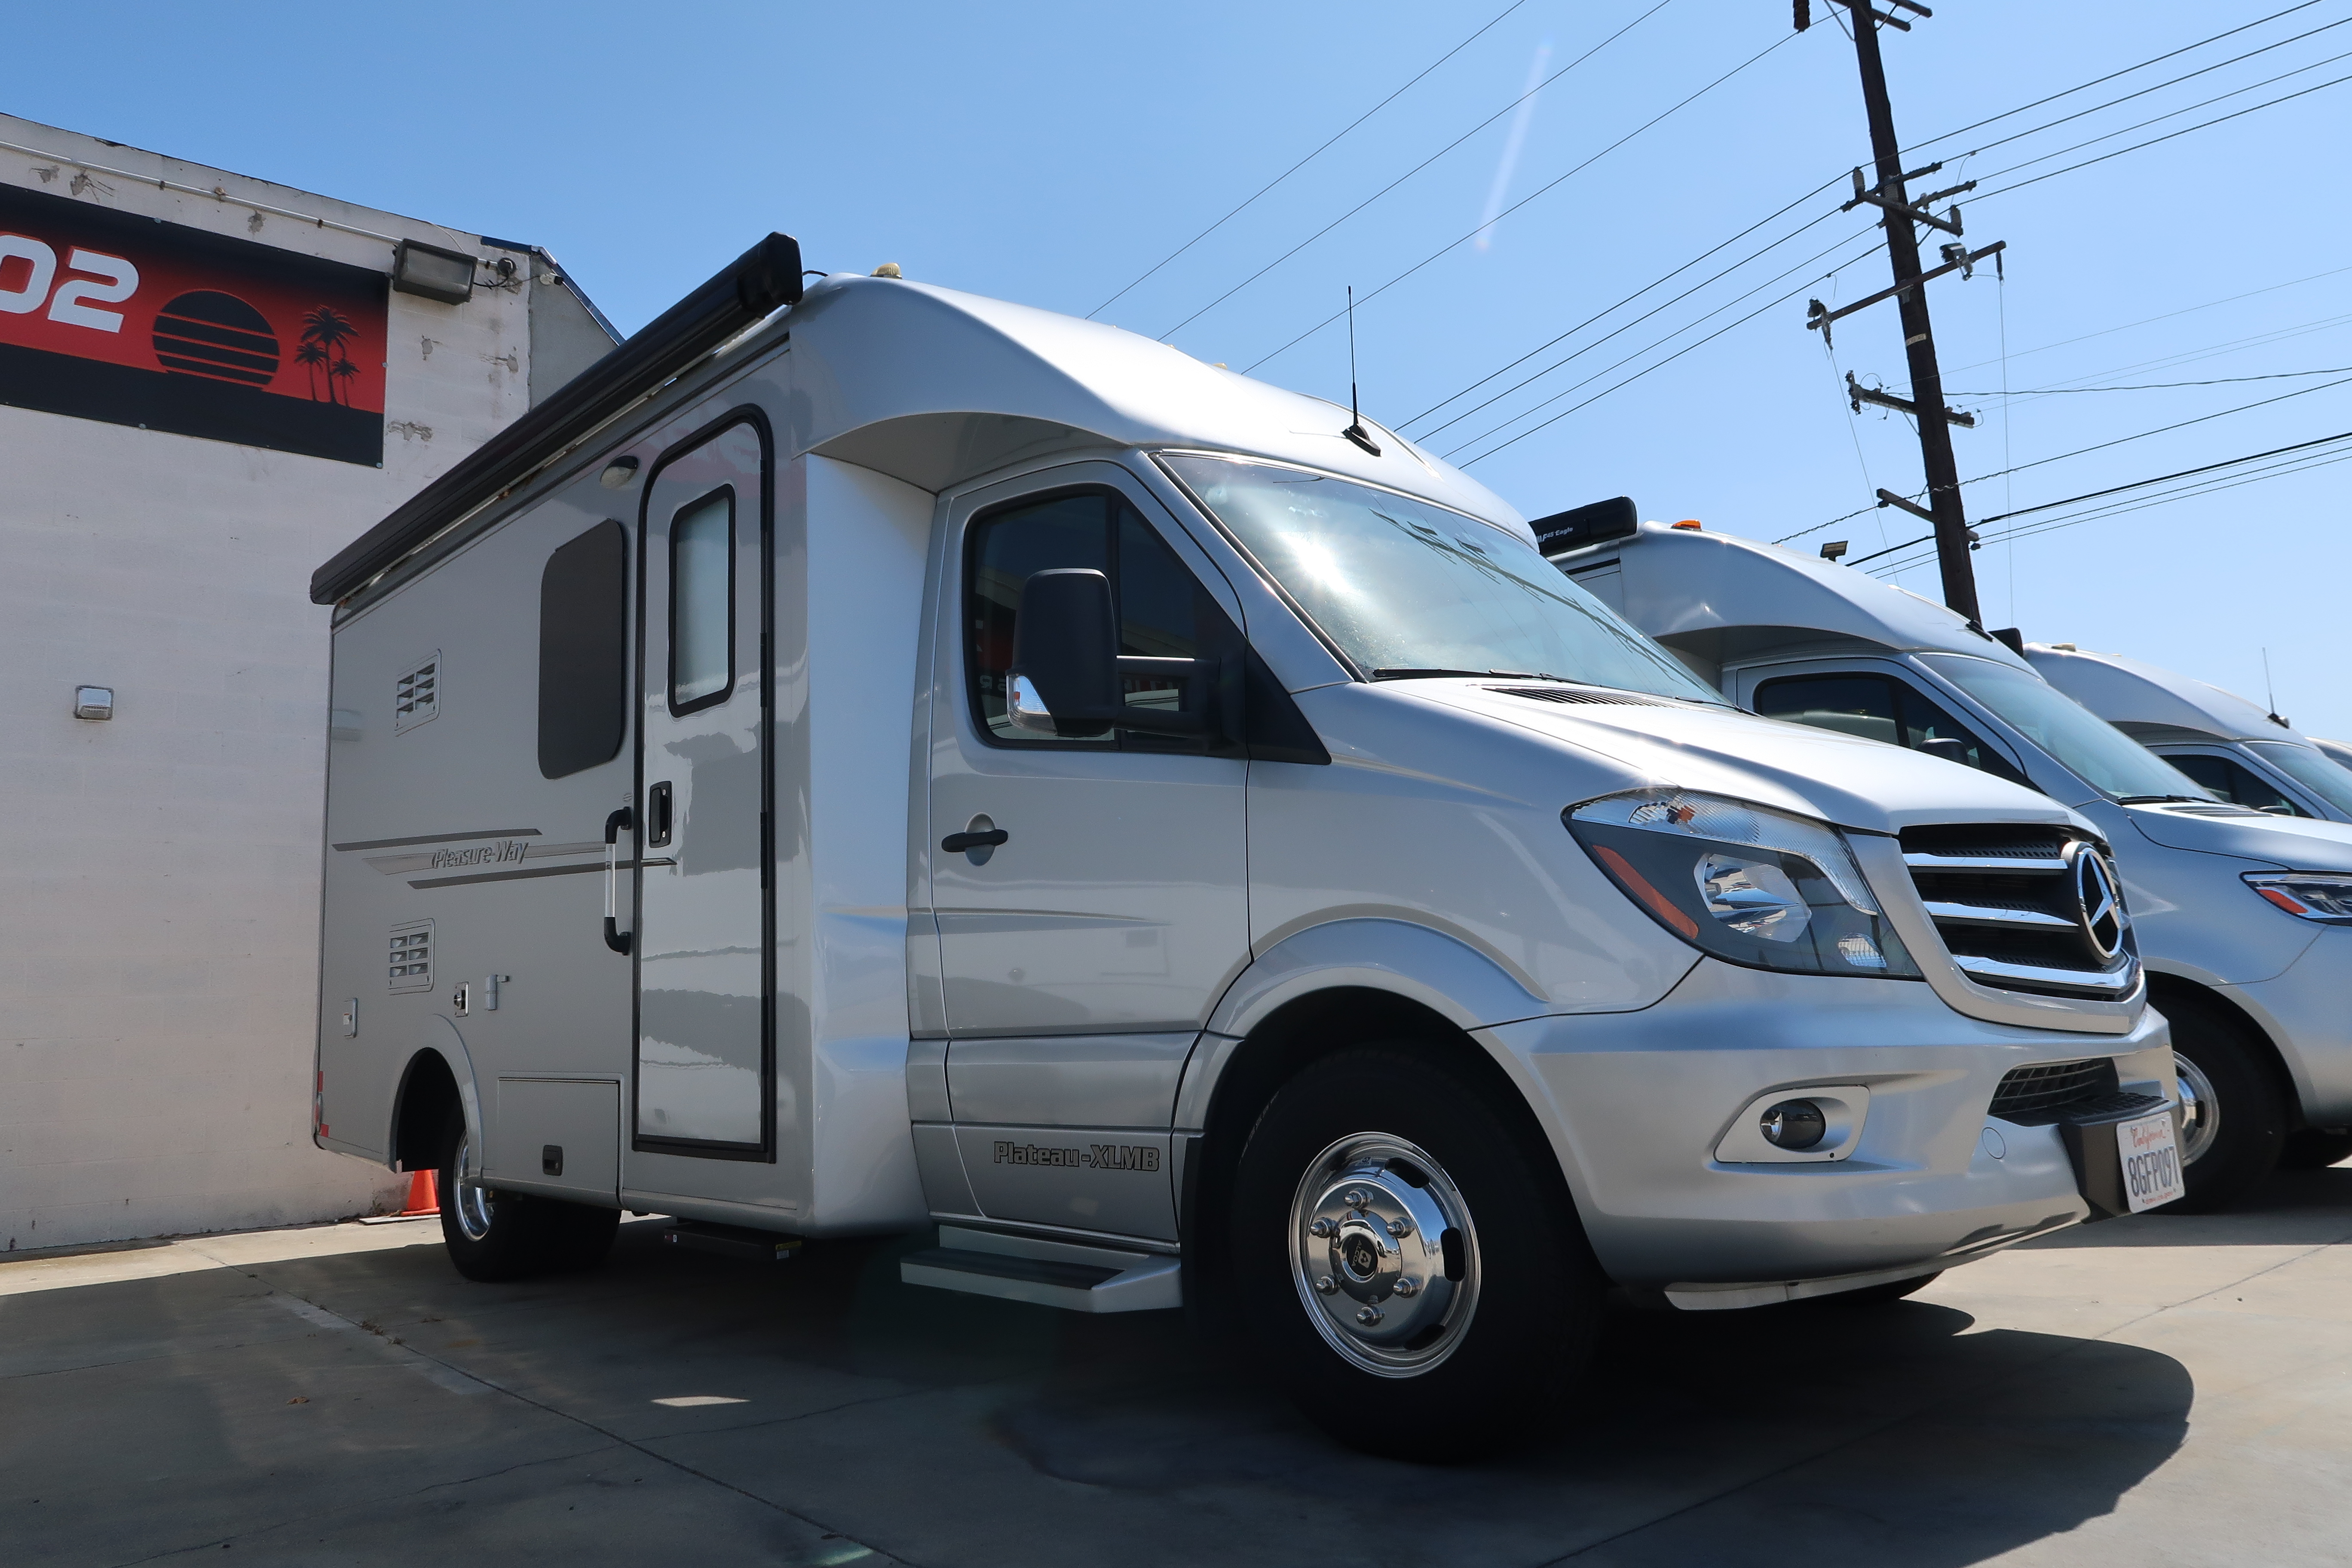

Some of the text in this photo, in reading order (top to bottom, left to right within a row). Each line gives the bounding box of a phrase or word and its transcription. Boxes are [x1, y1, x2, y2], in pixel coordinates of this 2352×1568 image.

[1556, 527, 1573, 536] Eagle
[432, 840, 529, 869] Pleasure-Way
[994, 1141, 1160, 1172] Plateau-XLMB
[2128, 1145, 2179, 1197] 8GFP097
[1351, 1240, 1362, 1266] ALCOA
